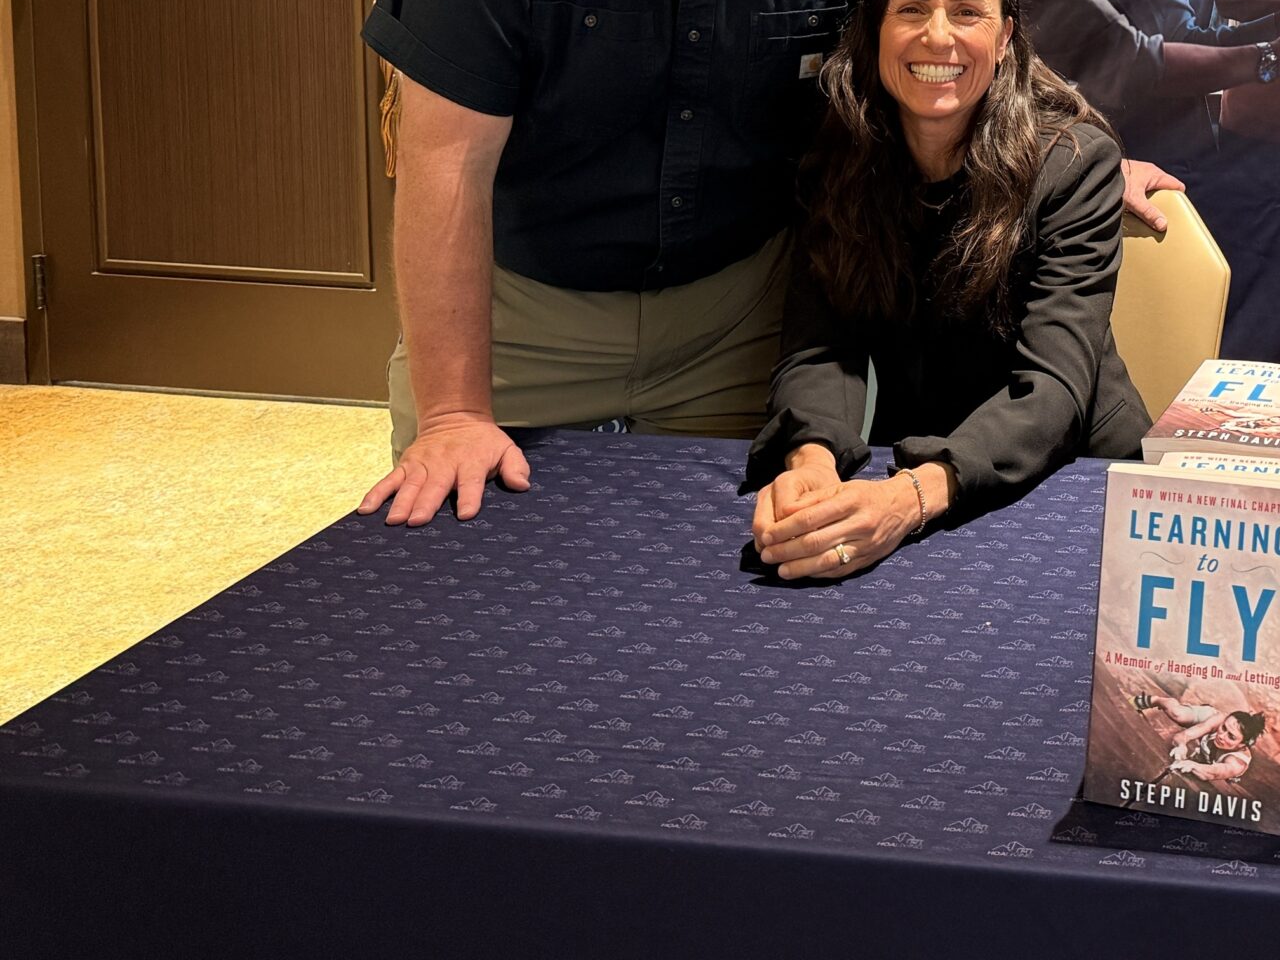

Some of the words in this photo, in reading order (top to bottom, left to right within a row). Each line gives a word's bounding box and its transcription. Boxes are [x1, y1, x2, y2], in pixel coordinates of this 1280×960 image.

[1174, 429, 1230, 441] STEPH
[1131, 487, 1153, 499] NOW
[1159, 490, 1183, 502] WITH
[1186, 493, 1192, 503] A
[1196, 494, 1216, 506] NEW
[1220, 497, 1247, 510] FINAL
[1196, 553, 1218, 572] to
[1136, 574, 1276, 662] FLY
[1105, 652, 1112, 664] A
[1114, 653, 1153, 670] Memoir
[1154, 662, 1164, 673] of
[1167, 659, 1207, 679] Hanging
[1210, 665, 1223, 678] On
[1225, 672, 1243, 682] and
[1244, 669, 1280, 690] Letting
[1120, 779, 1185, 808] STEPH
[1198, 791, 1261, 821] DAVIS
